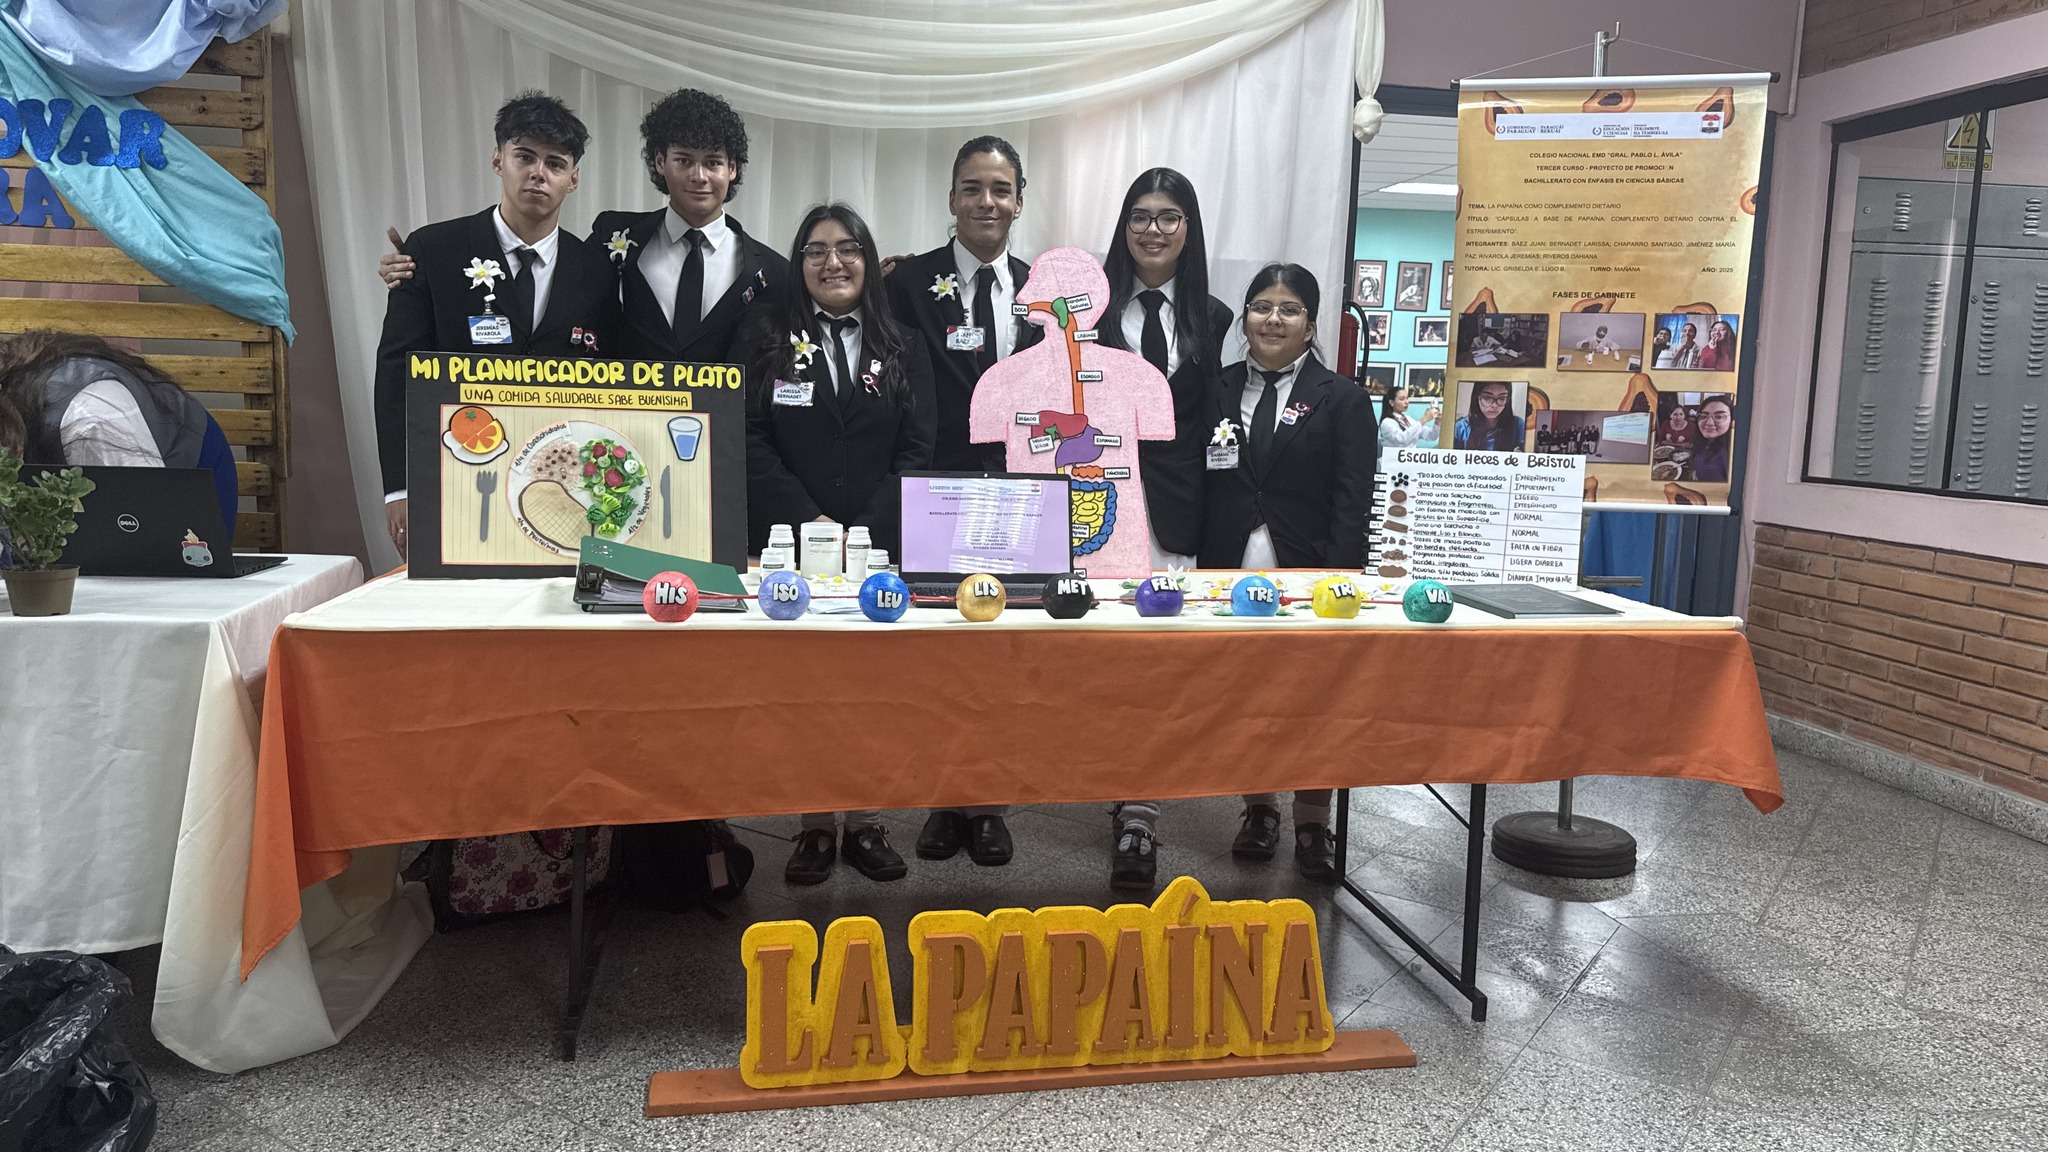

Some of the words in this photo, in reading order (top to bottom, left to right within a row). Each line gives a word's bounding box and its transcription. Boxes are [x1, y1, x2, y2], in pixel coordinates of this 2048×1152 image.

[1552, 291, 1578, 299] FASES
[1581, 291, 1592, 299] DE
[1594, 291, 1636, 299] GABINETE
[411, 355, 440, 380] MI
[449, 356, 625, 385] PLANIFICADOR
[633, 362, 664, 388] DE
[674, 364, 742, 390] PLATO
[464, 389, 493, 402] UNA
[499, 389, 540, 403] COMIDA
[545, 392, 604, 404] SALUDABLE
[608, 393, 633, 406] SABE
[522, 448, 531, 457] de
[1398, 449, 1439, 465] Escala
[1443, 453, 1458, 465] de
[1504, 454, 1519, 467] de
[1514, 483, 1555, 492] IMPORTANTE
[1513, 512, 1543, 521] NORMAL
[1511, 529, 1539, 537] NORMAL
[1510, 542, 1530, 551] FALTA
[1542, 544, 1563, 553] FIBRA
[1510, 557, 1532, 566] LIGERA
[1535, 559, 1563, 568] DIARREA
[1150, 576, 1180, 593] FEN
[1507, 573, 1533, 582] DIARREA
[654, 582, 688, 605] HIS
[773, 582, 799, 602] ISO
[974, 581, 999, 597] LIS
[1057, 578, 1088, 596] MET
[1246, 586, 1274, 603] TRE
[1329, 582, 1357, 598] TRI
[877, 589, 903, 609] LEU
[1425, 588, 1453, 604] VAL
[755, 939, 890, 1074] LA
[923, 892, 1330, 1062] PAPAÍNA
